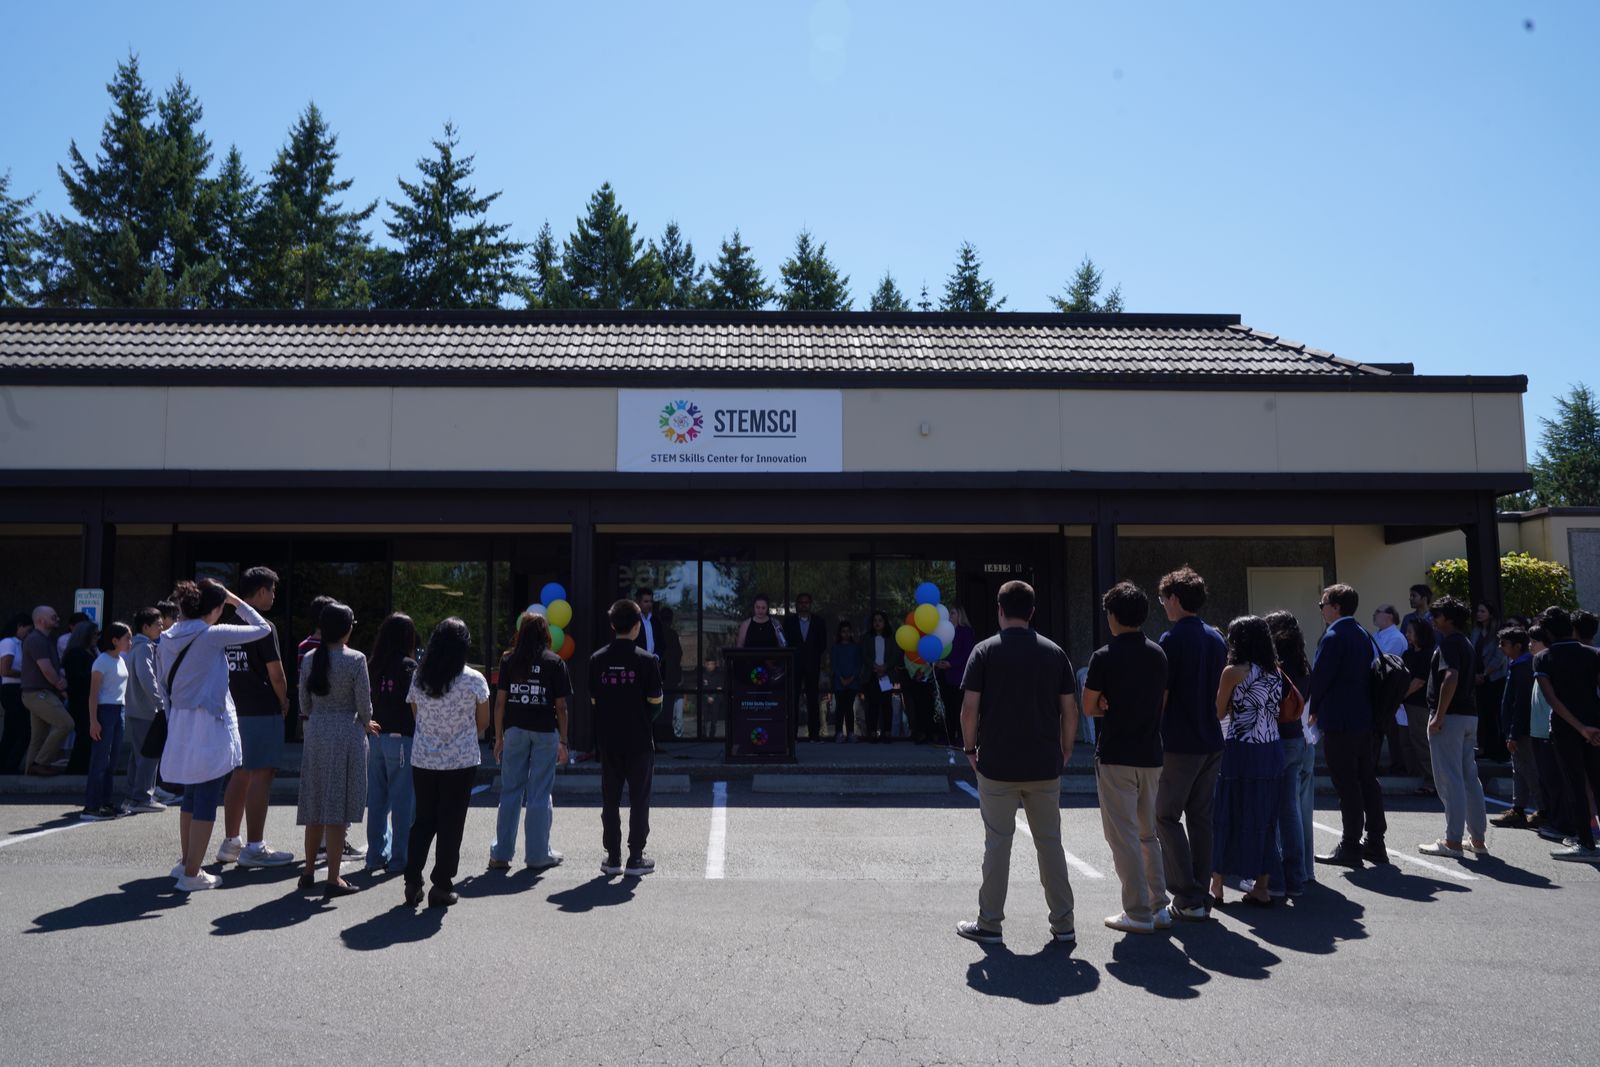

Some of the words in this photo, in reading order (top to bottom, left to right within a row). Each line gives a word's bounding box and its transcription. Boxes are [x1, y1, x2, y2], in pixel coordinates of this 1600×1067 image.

[714, 409, 797, 433] STEMSCI
[650, 453, 677, 463] STEM
[679, 453, 705, 463] Skills
[707, 453, 737, 463] Center
[740, 453, 753, 463] for
[756, 453, 807, 463] Innovation
